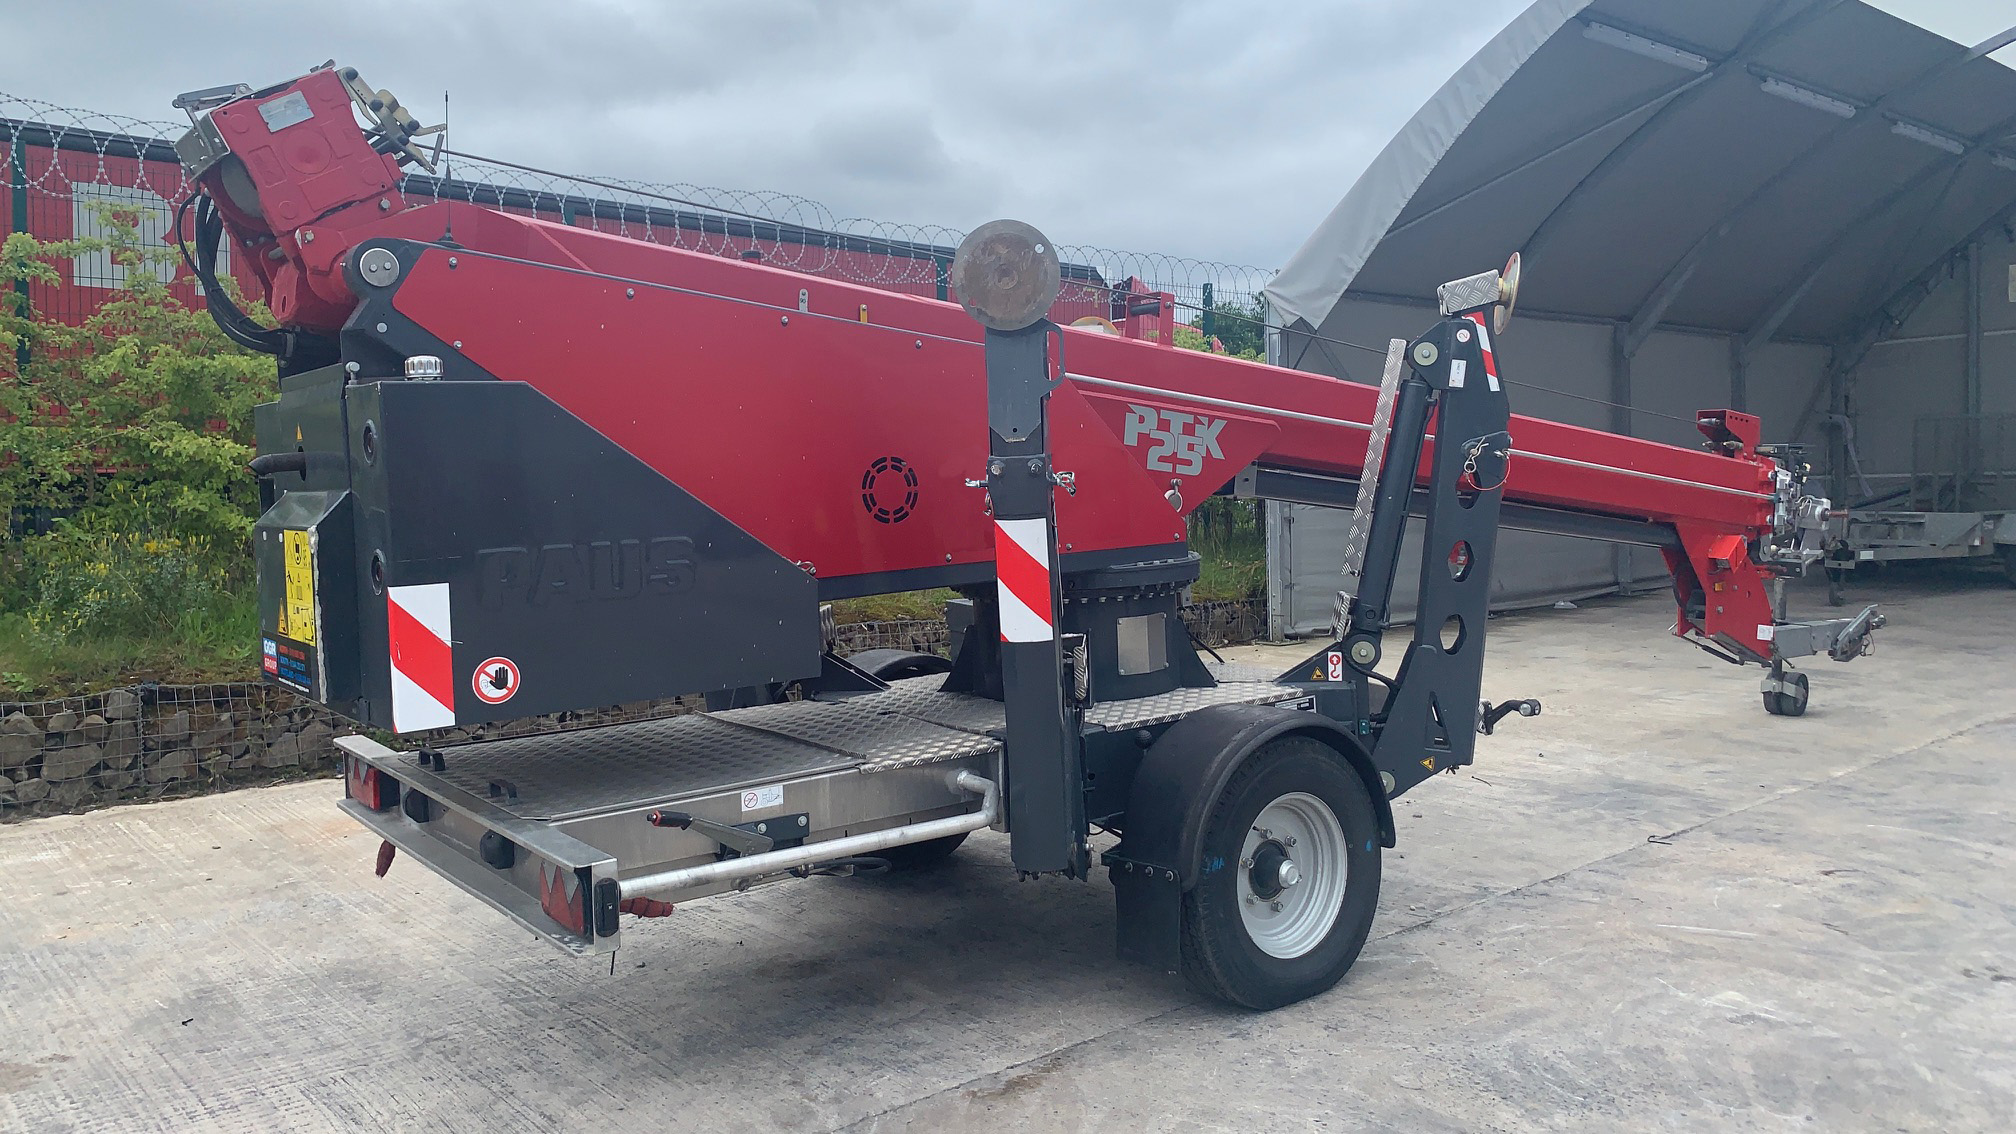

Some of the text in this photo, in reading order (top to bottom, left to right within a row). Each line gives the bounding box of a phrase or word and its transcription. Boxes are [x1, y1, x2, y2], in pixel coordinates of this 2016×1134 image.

[1123, 403, 1228, 461] PTK
[1146, 429, 1204, 476] 25
[475, 536, 697, 609] PAUS
